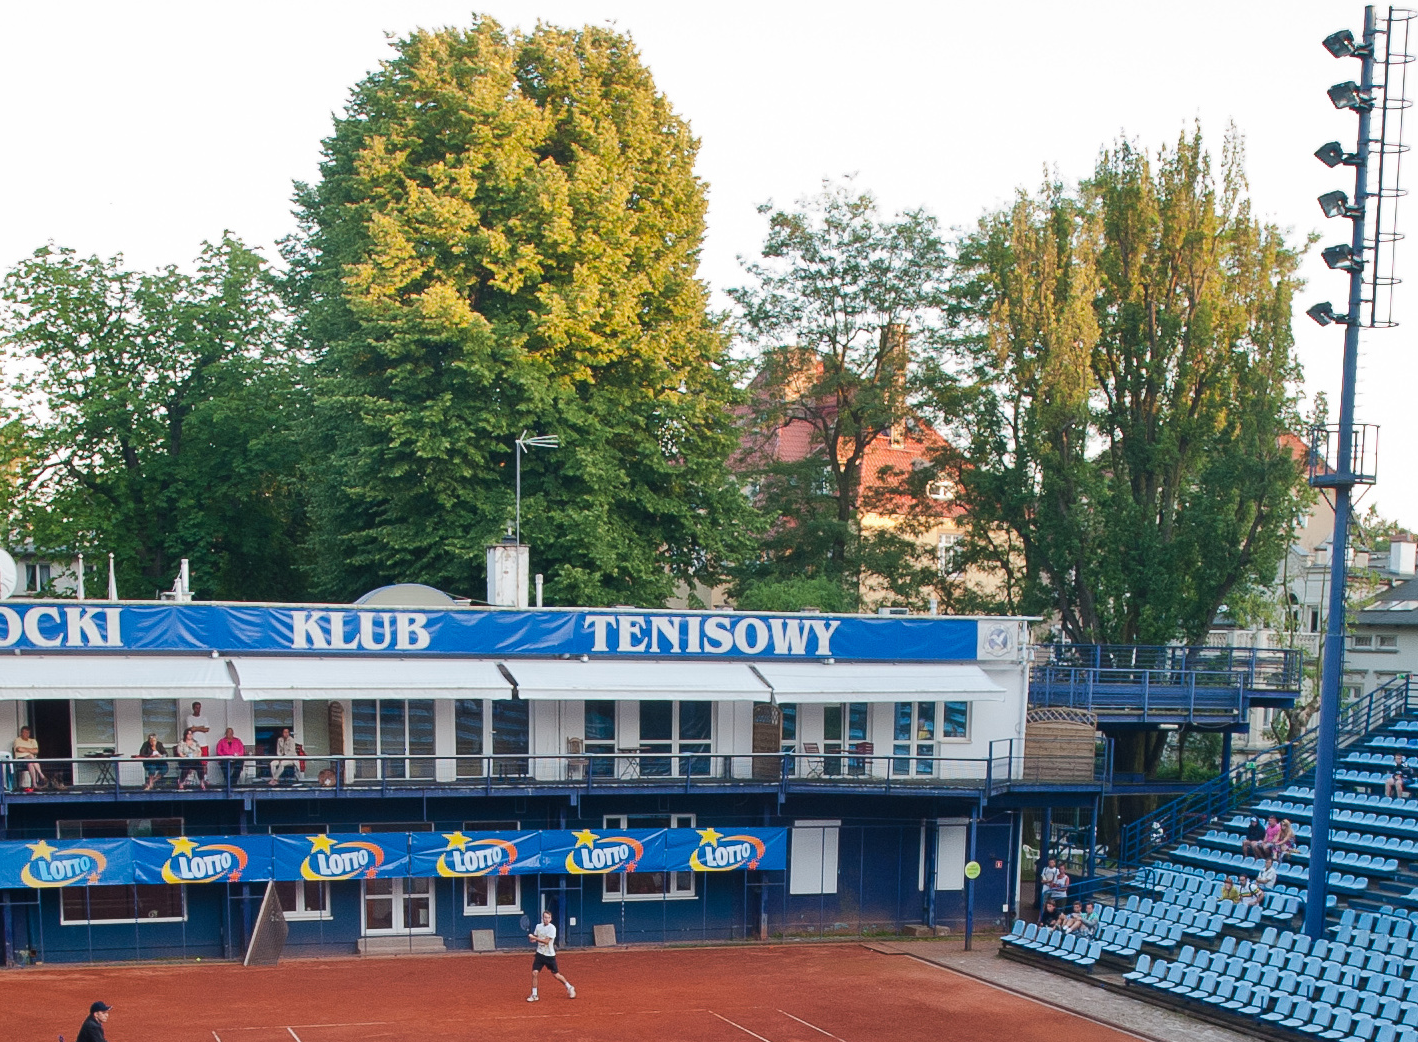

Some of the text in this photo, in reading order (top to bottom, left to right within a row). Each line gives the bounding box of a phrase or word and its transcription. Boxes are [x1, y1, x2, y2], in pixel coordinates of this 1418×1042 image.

[290, 610, 431, 650] KLUB
[583, 615, 841, 655] TENISOWY
[179, 852, 232, 879] LOTTO
[317, 849, 369, 875] LOTTO
[453, 846, 503, 872] LOTTO
[581, 844, 629, 869] LOTTO
[705, 842, 751, 867] LOTTO
[38, 856, 91, 881] LOTTO
